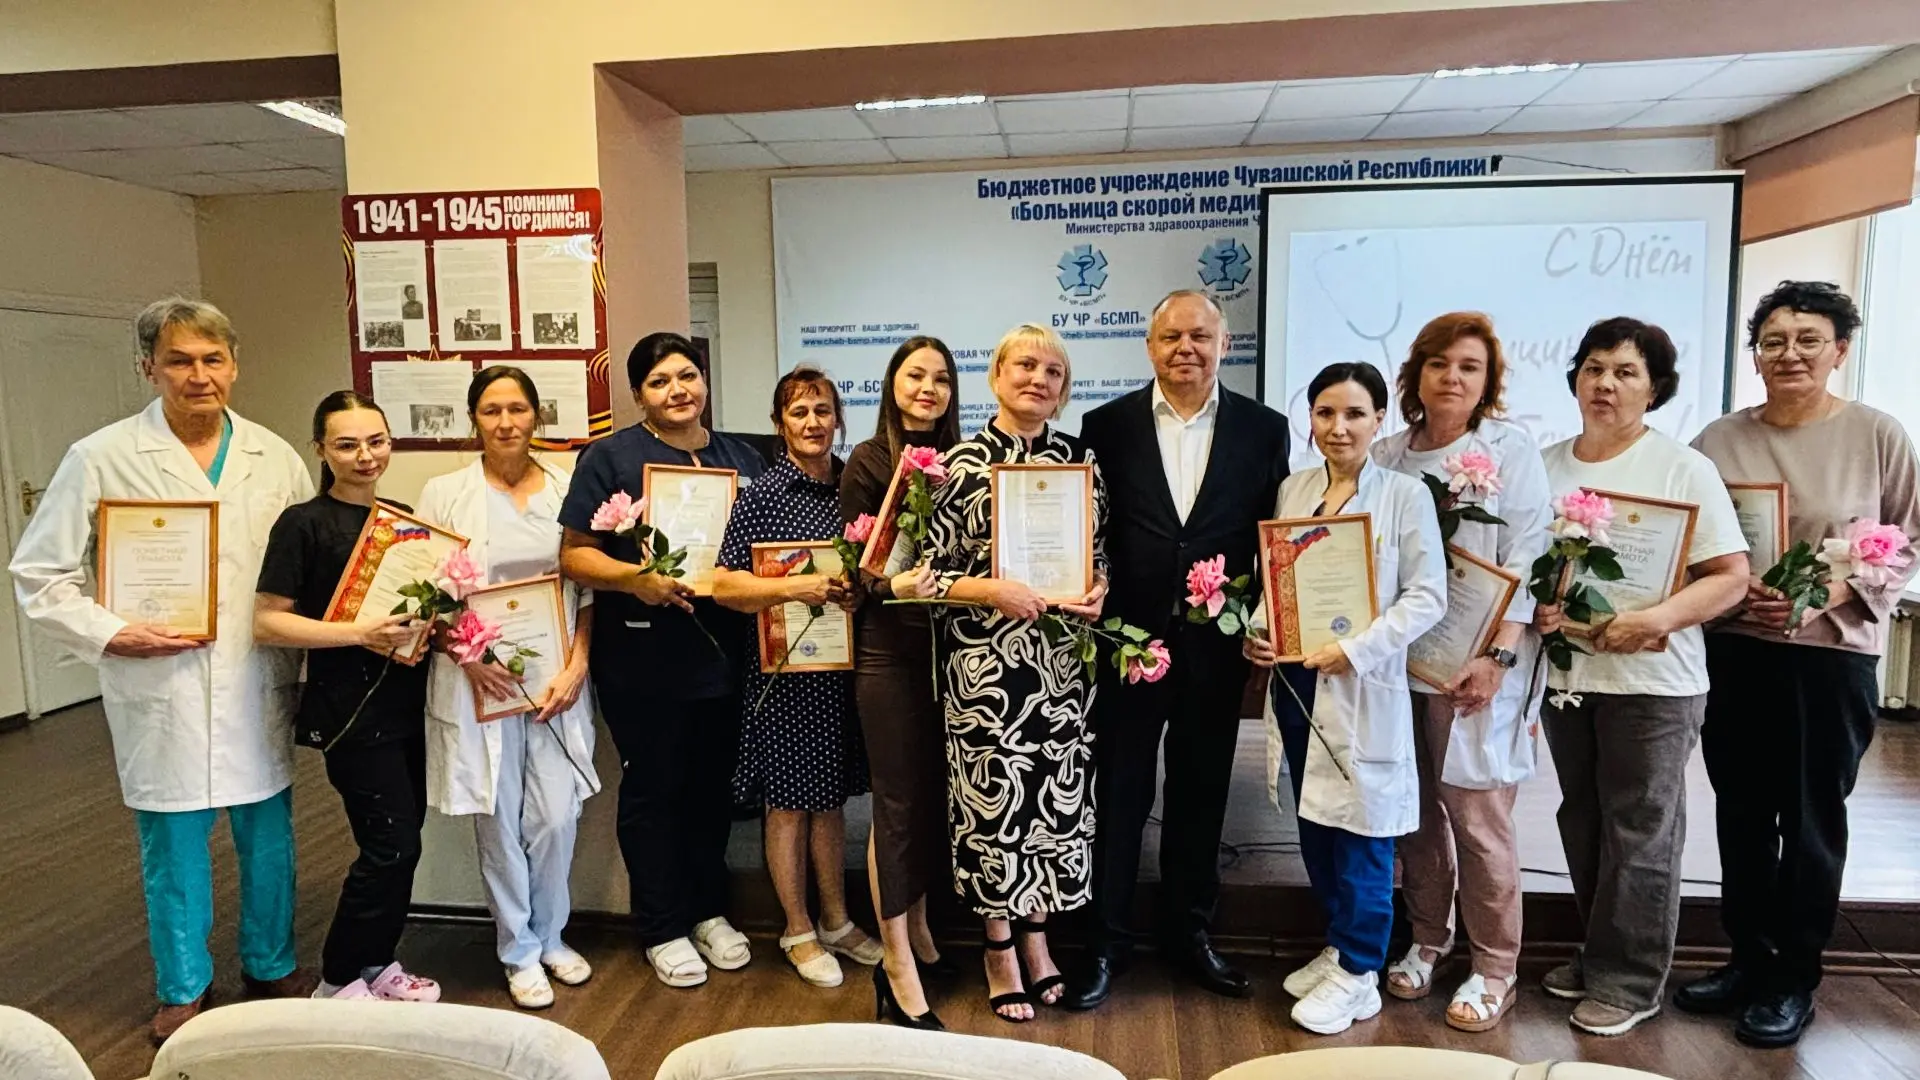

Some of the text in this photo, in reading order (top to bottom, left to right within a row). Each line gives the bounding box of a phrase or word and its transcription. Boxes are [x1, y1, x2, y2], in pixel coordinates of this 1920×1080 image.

[978, 157, 1486, 199] Бюджетное учреждение Чувашской Республики
[503, 194, 575, 213] ПОМНИМ!
[1011, 200, 1118, 221] «Больница
[1122, 192, 1194, 217] скорой
[353, 196, 503, 234] 1941-1945
[503, 211, 590, 232] ГОРДИМСЯ!
[1066, 221, 1145, 235] Министерства
[1148, 217, 1249, 233] здравоохранения
[1051, 310, 1146, 327] БУ ЧР «БСМП»
[838, 380, 854, 393] ЧР
